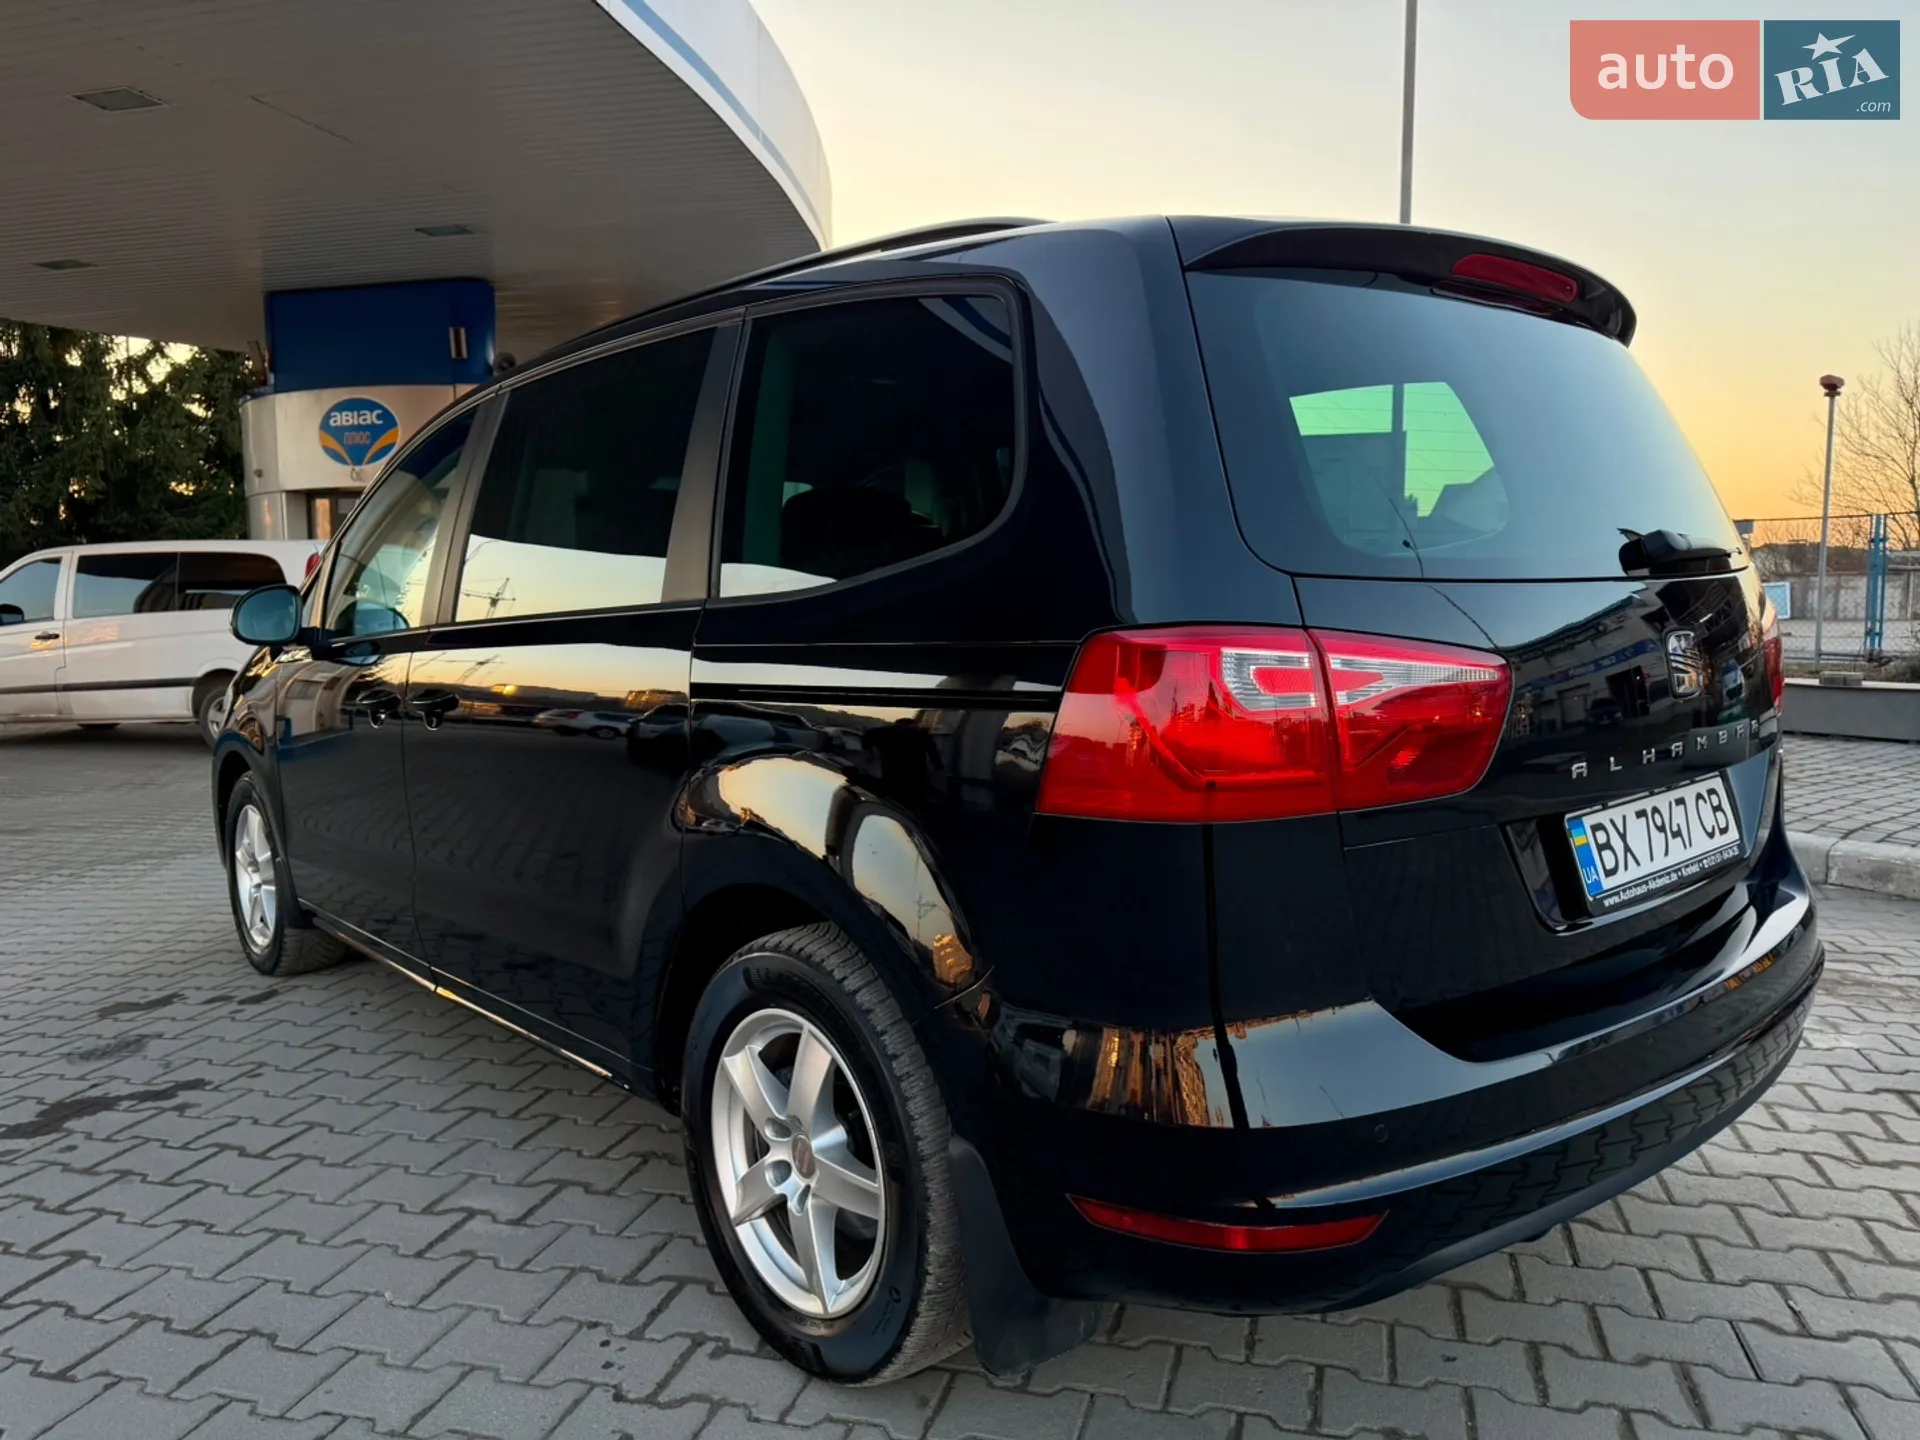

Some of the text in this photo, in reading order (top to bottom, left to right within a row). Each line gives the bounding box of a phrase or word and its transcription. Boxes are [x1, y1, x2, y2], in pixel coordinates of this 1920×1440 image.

[1571, 719, 1759, 780] ALHAMBRA
[1589, 787, 1730, 879] BX 7947 CB
[1583, 866, 1600, 885] UA
